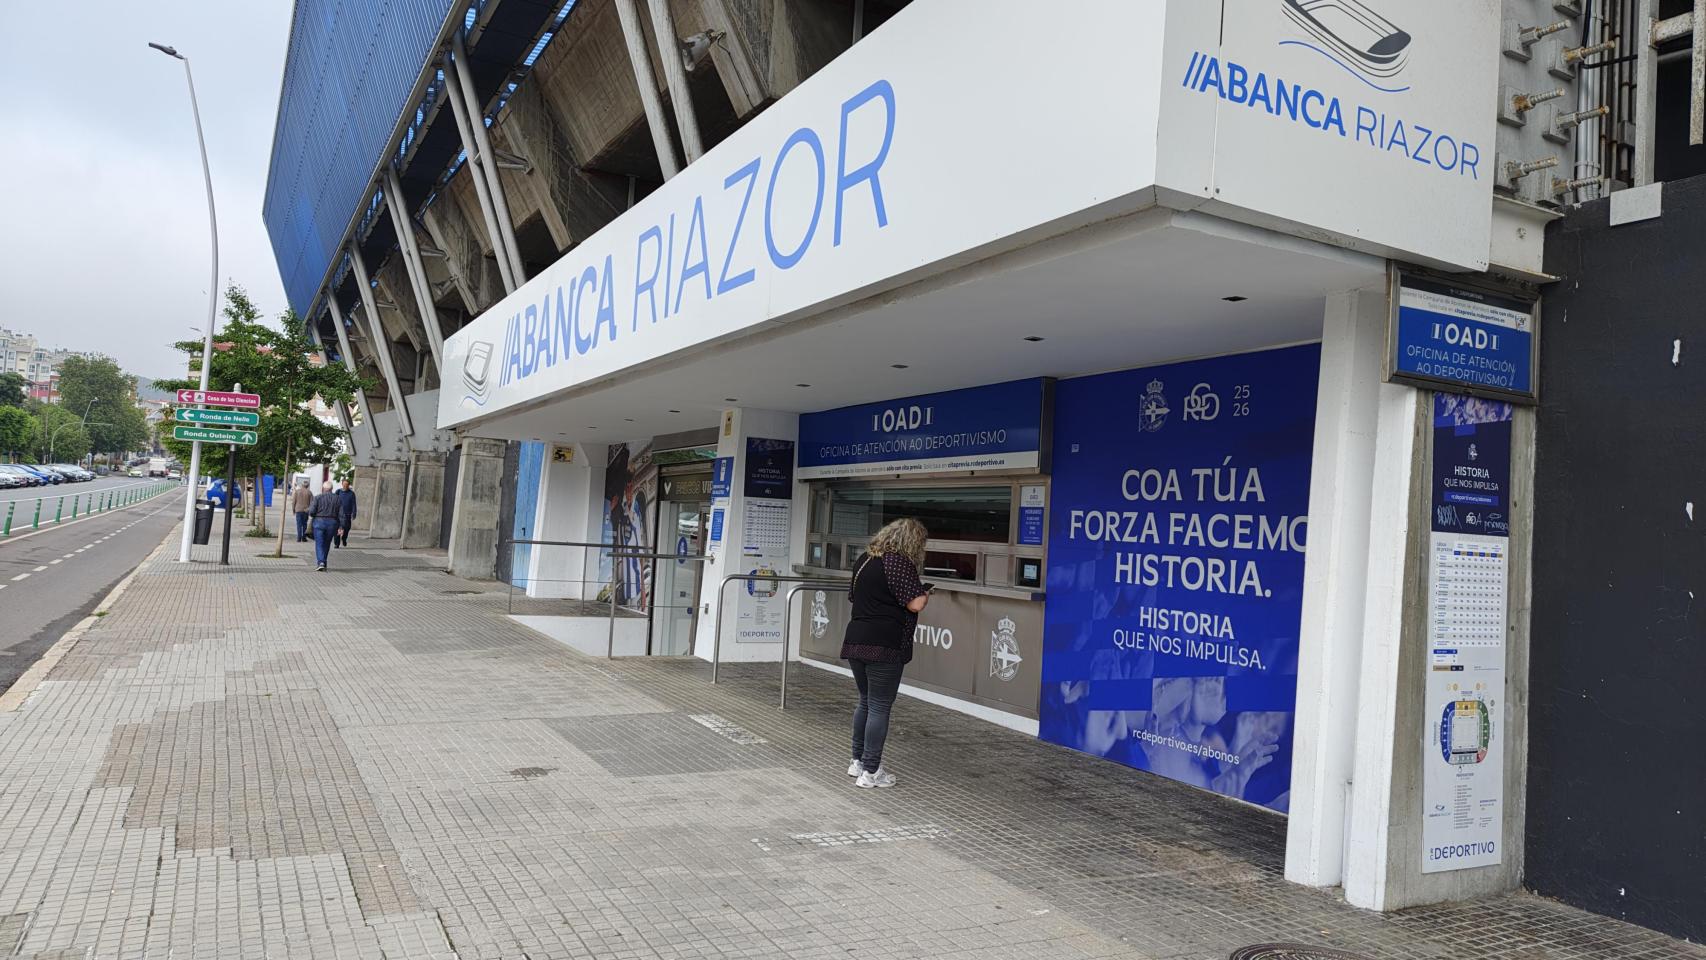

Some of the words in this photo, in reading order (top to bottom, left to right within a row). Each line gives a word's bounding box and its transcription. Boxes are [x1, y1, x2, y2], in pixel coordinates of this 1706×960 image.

[1356, 106, 1479, 180] RIAZOR
[632, 79, 896, 333] RIAZOR
[1407, 344, 1449, 362] OFICINA
[1452, 352, 1466, 365] DE
[1468, 356, 1515, 373] ATENCIÓN
[1416, 362, 1431, 375] AO
[1434, 364, 1508, 387] DEPORTIVISMO
[1234, 384, 1250, 399] 25
[199, 413, 222, 421] Ronda
[1233, 402, 1250, 416] 26
[183, 430, 207, 438] Ronda
[209, 431, 237, 440] Outeiro
[820, 444, 850, 459] OFICINA
[851, 443, 862, 456] DE
[909, 438, 923, 451] AO
[925, 430, 1007, 450] DEPORTIVISMO
[1121, 469, 1182, 501] COA
[1191, 455, 1265, 502] TÚA
[1444, 478, 1458, 488] QUE
[1459, 479, 1472, 489] NOS
[1473, 480, 1499, 491] IMPULSA
[1454, 465, 1490, 479] HISTORIA
[1069, 510, 1160, 544] FORZA
[1114, 552, 1272, 598] HISTORIA.
[1139, 606, 1235, 640] HISTORIA
[1113, 628, 1145, 650] QUE
[1148, 634, 1181, 656] NOS
[1186, 639, 1266, 670] IMPULSA.
[1132, 728, 1240, 765] rcdeportivo.es/abonos
[1434, 841, 1495, 860] DEPORTIVO
